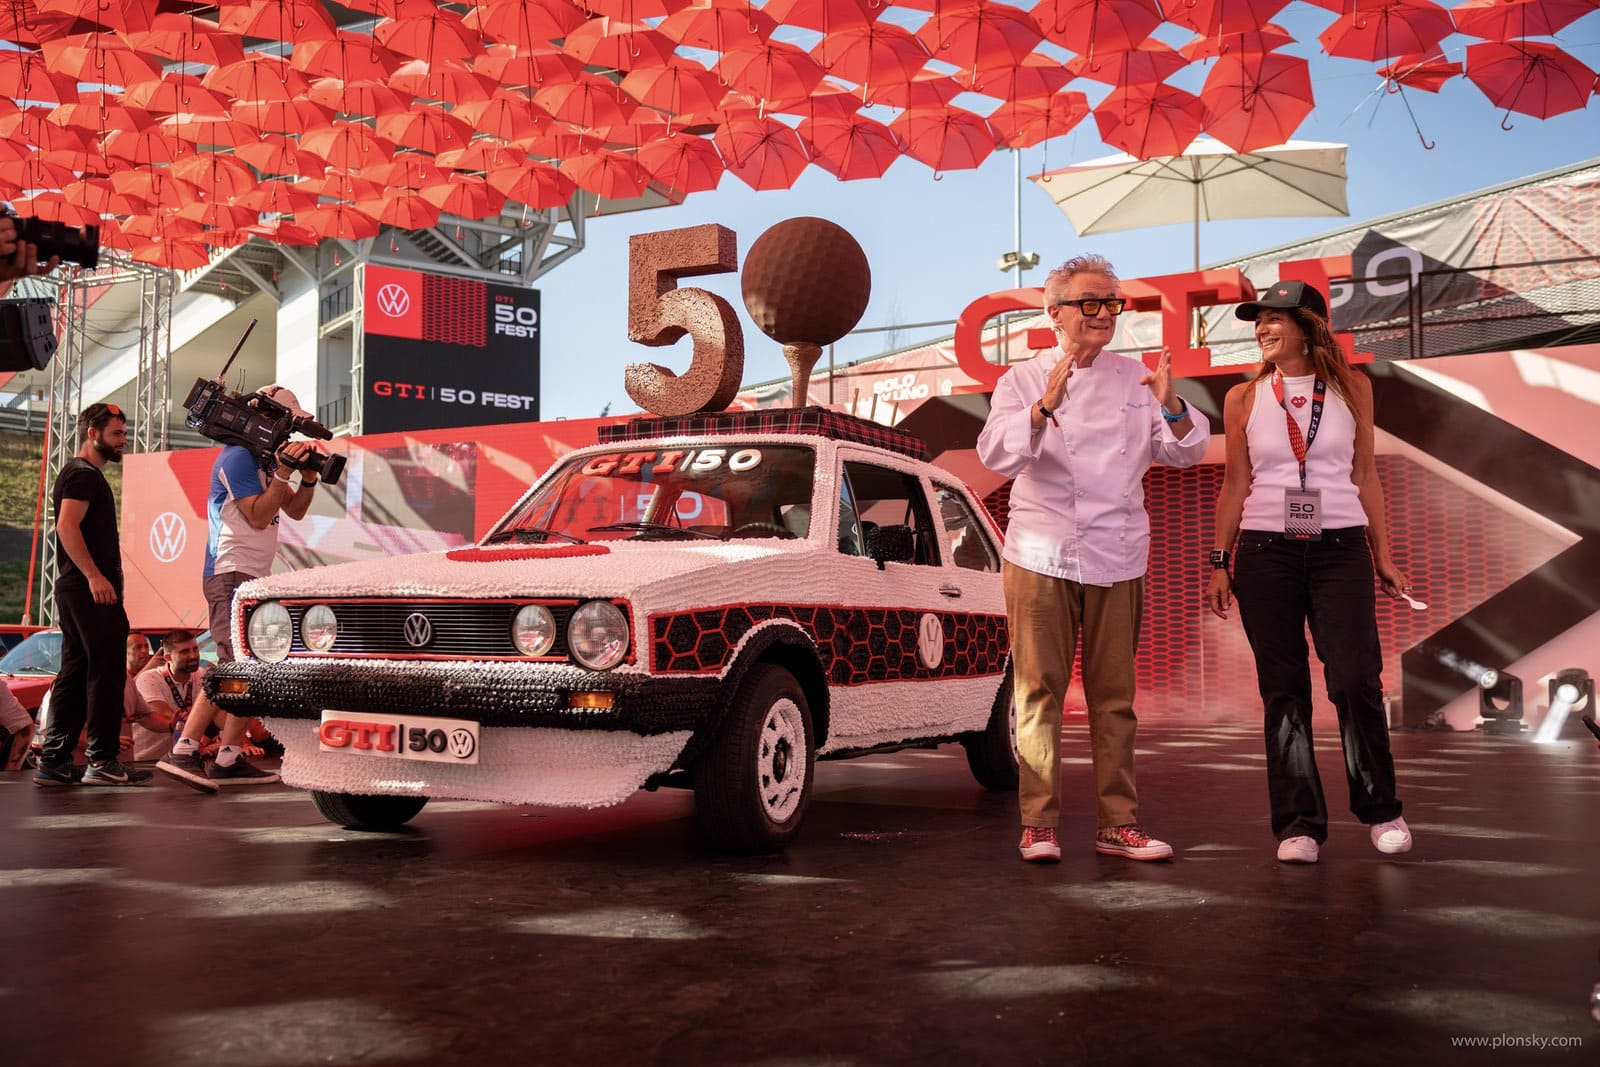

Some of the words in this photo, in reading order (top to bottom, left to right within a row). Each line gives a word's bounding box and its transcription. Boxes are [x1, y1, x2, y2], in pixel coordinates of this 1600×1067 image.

[495, 303, 537, 325] 50
[495, 322, 537, 338] FEST
[373, 381, 426, 399] GTI
[440, 387, 475, 404] 50
[481, 392, 534, 410] FEST
[582, 450, 685, 476] GTI
[691, 449, 762, 472] 50
[1290, 503, 1315, 513] 50
[319, 720, 396, 751] GTI
[409, 728, 448, 753] 50
